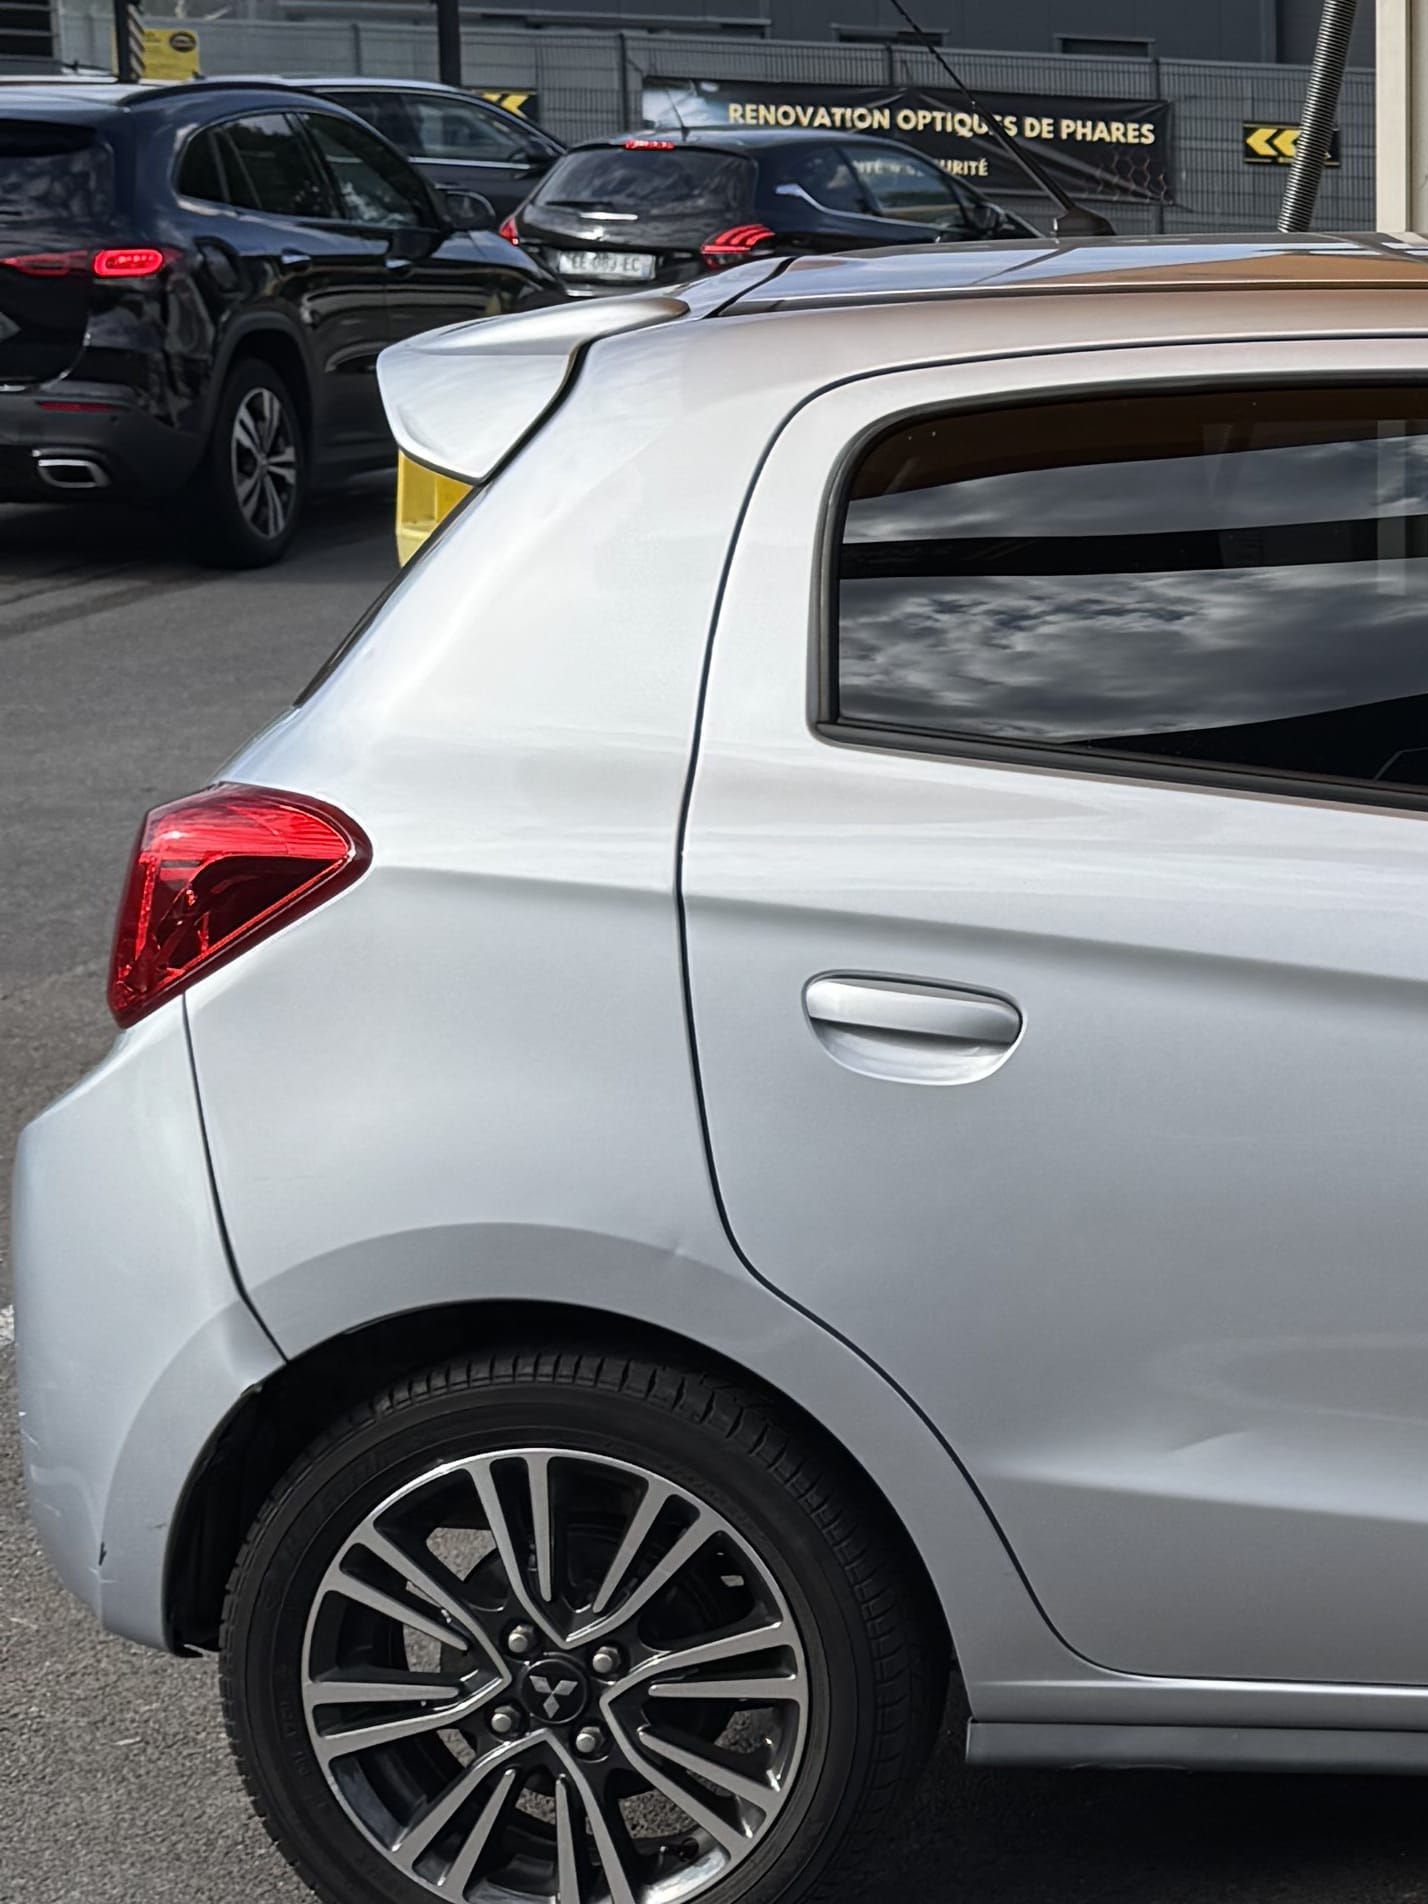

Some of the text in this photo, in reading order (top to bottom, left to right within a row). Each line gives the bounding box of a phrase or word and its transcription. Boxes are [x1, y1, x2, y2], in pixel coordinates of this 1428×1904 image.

[727, 103, 1156, 145] RENOVATION OPTIQUS DE PHARES
